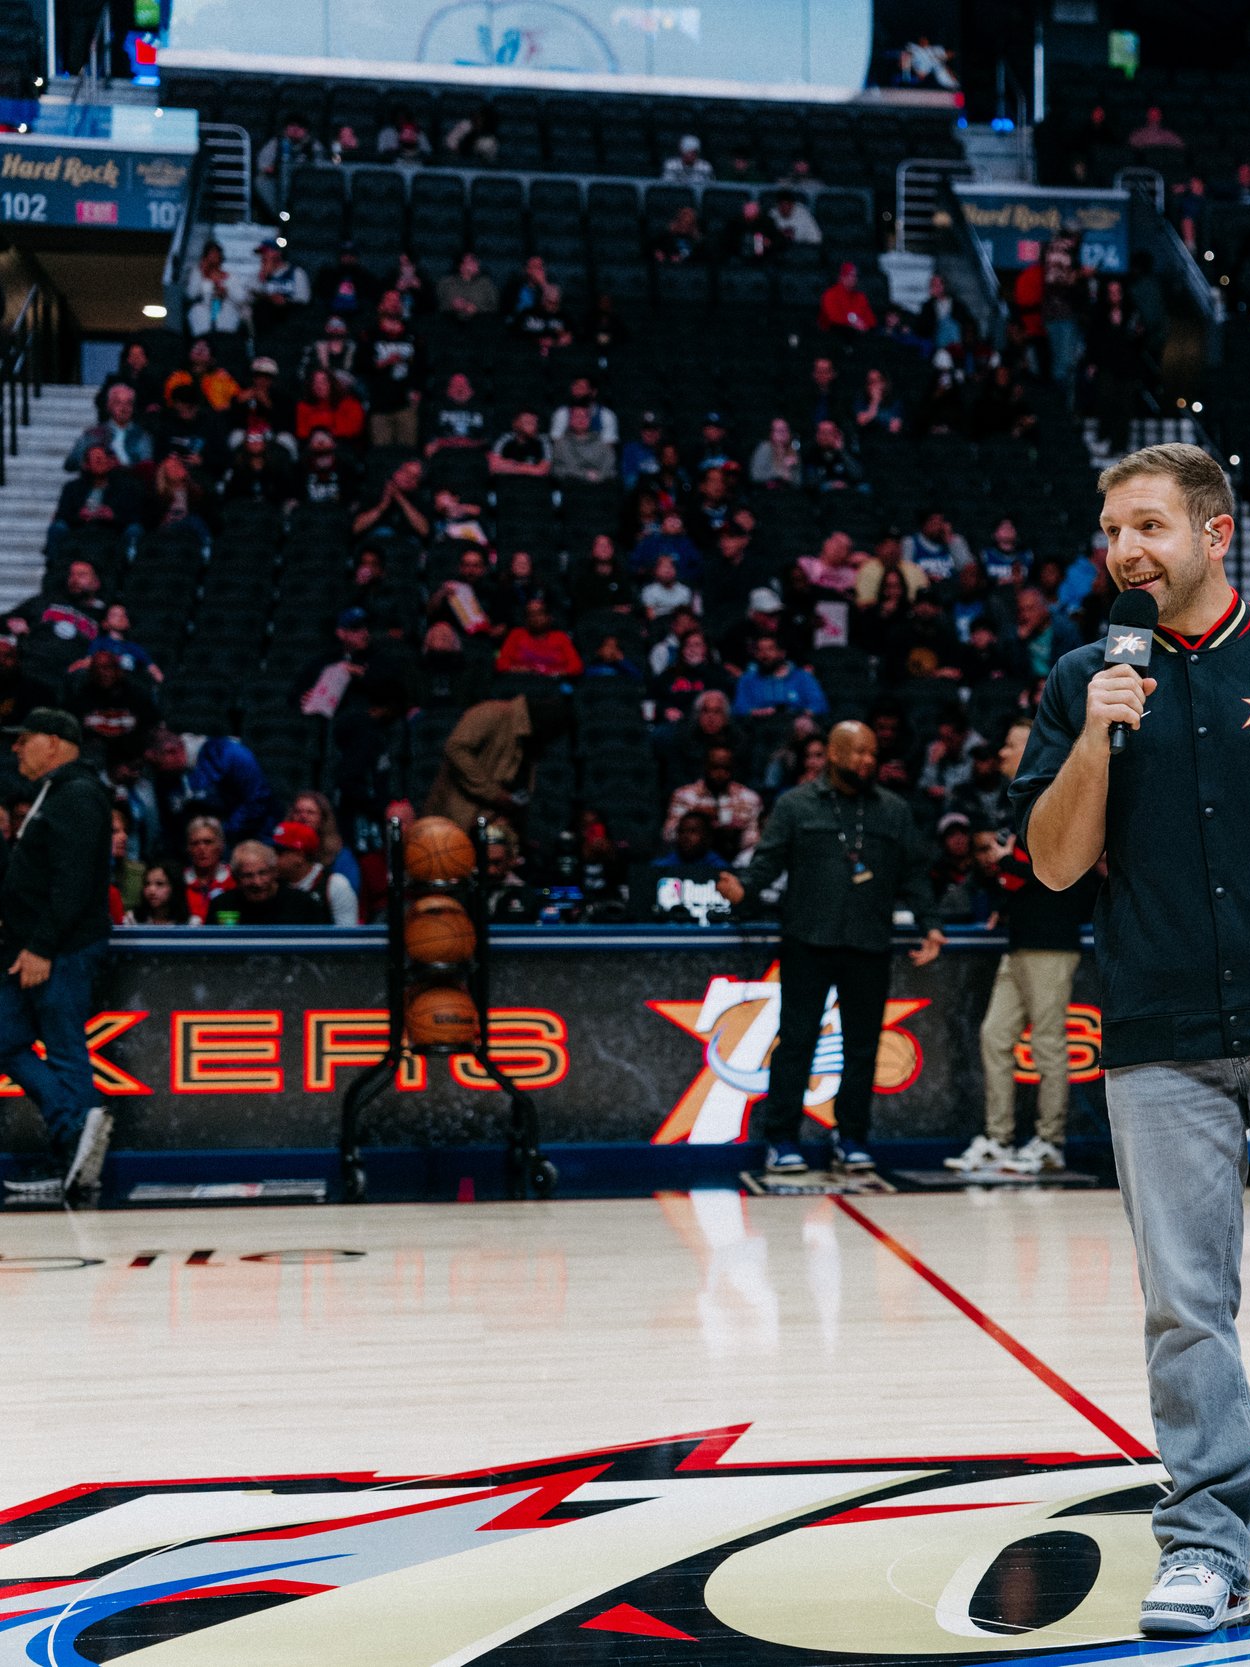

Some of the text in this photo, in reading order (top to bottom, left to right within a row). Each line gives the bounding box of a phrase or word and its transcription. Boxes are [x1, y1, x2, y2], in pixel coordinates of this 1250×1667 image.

[2, 153, 62, 182] Hard
[63, 156, 119, 188] Rock
[1, 191, 47, 222] 102
